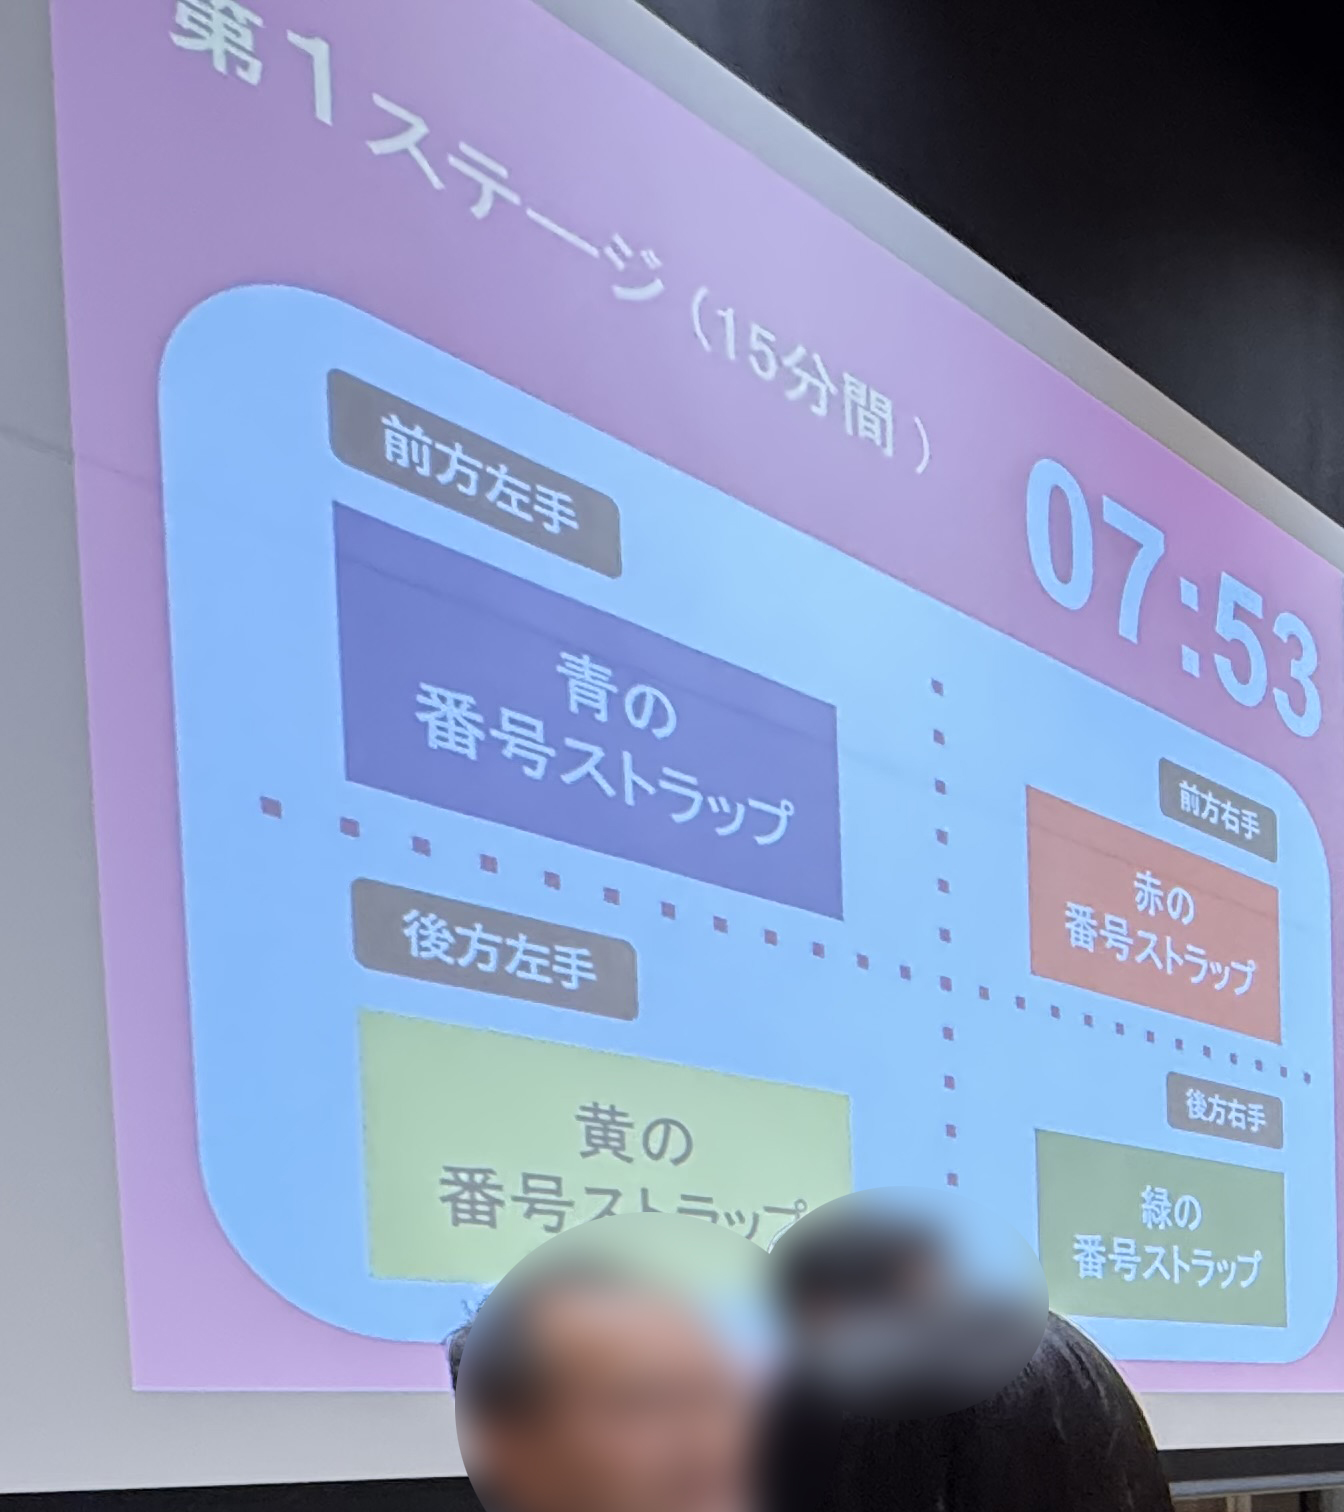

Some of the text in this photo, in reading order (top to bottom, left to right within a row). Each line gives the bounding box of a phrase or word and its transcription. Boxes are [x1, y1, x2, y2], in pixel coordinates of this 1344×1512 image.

[381, 415, 579, 535] 前方左手
[1026, 458, 1322, 738] 07:53
[556, 651, 677, 740] 青の
[415, 682, 795, 846] 番号ストラップ
[1178, 781, 1261, 840] 前方右手
[1133, 870, 1195, 924] 赤の
[403, 909, 598, 990] 後方左手
[1064, 900, 1257, 996] 番号ストラップ
[575, 1102, 694, 1166] 黄の
[1185, 1088, 1267, 1133] 後方右手
[1140, 1185, 1202, 1233] 緑の
[1072, 1233, 1263, 1289] 番号ストラップ
